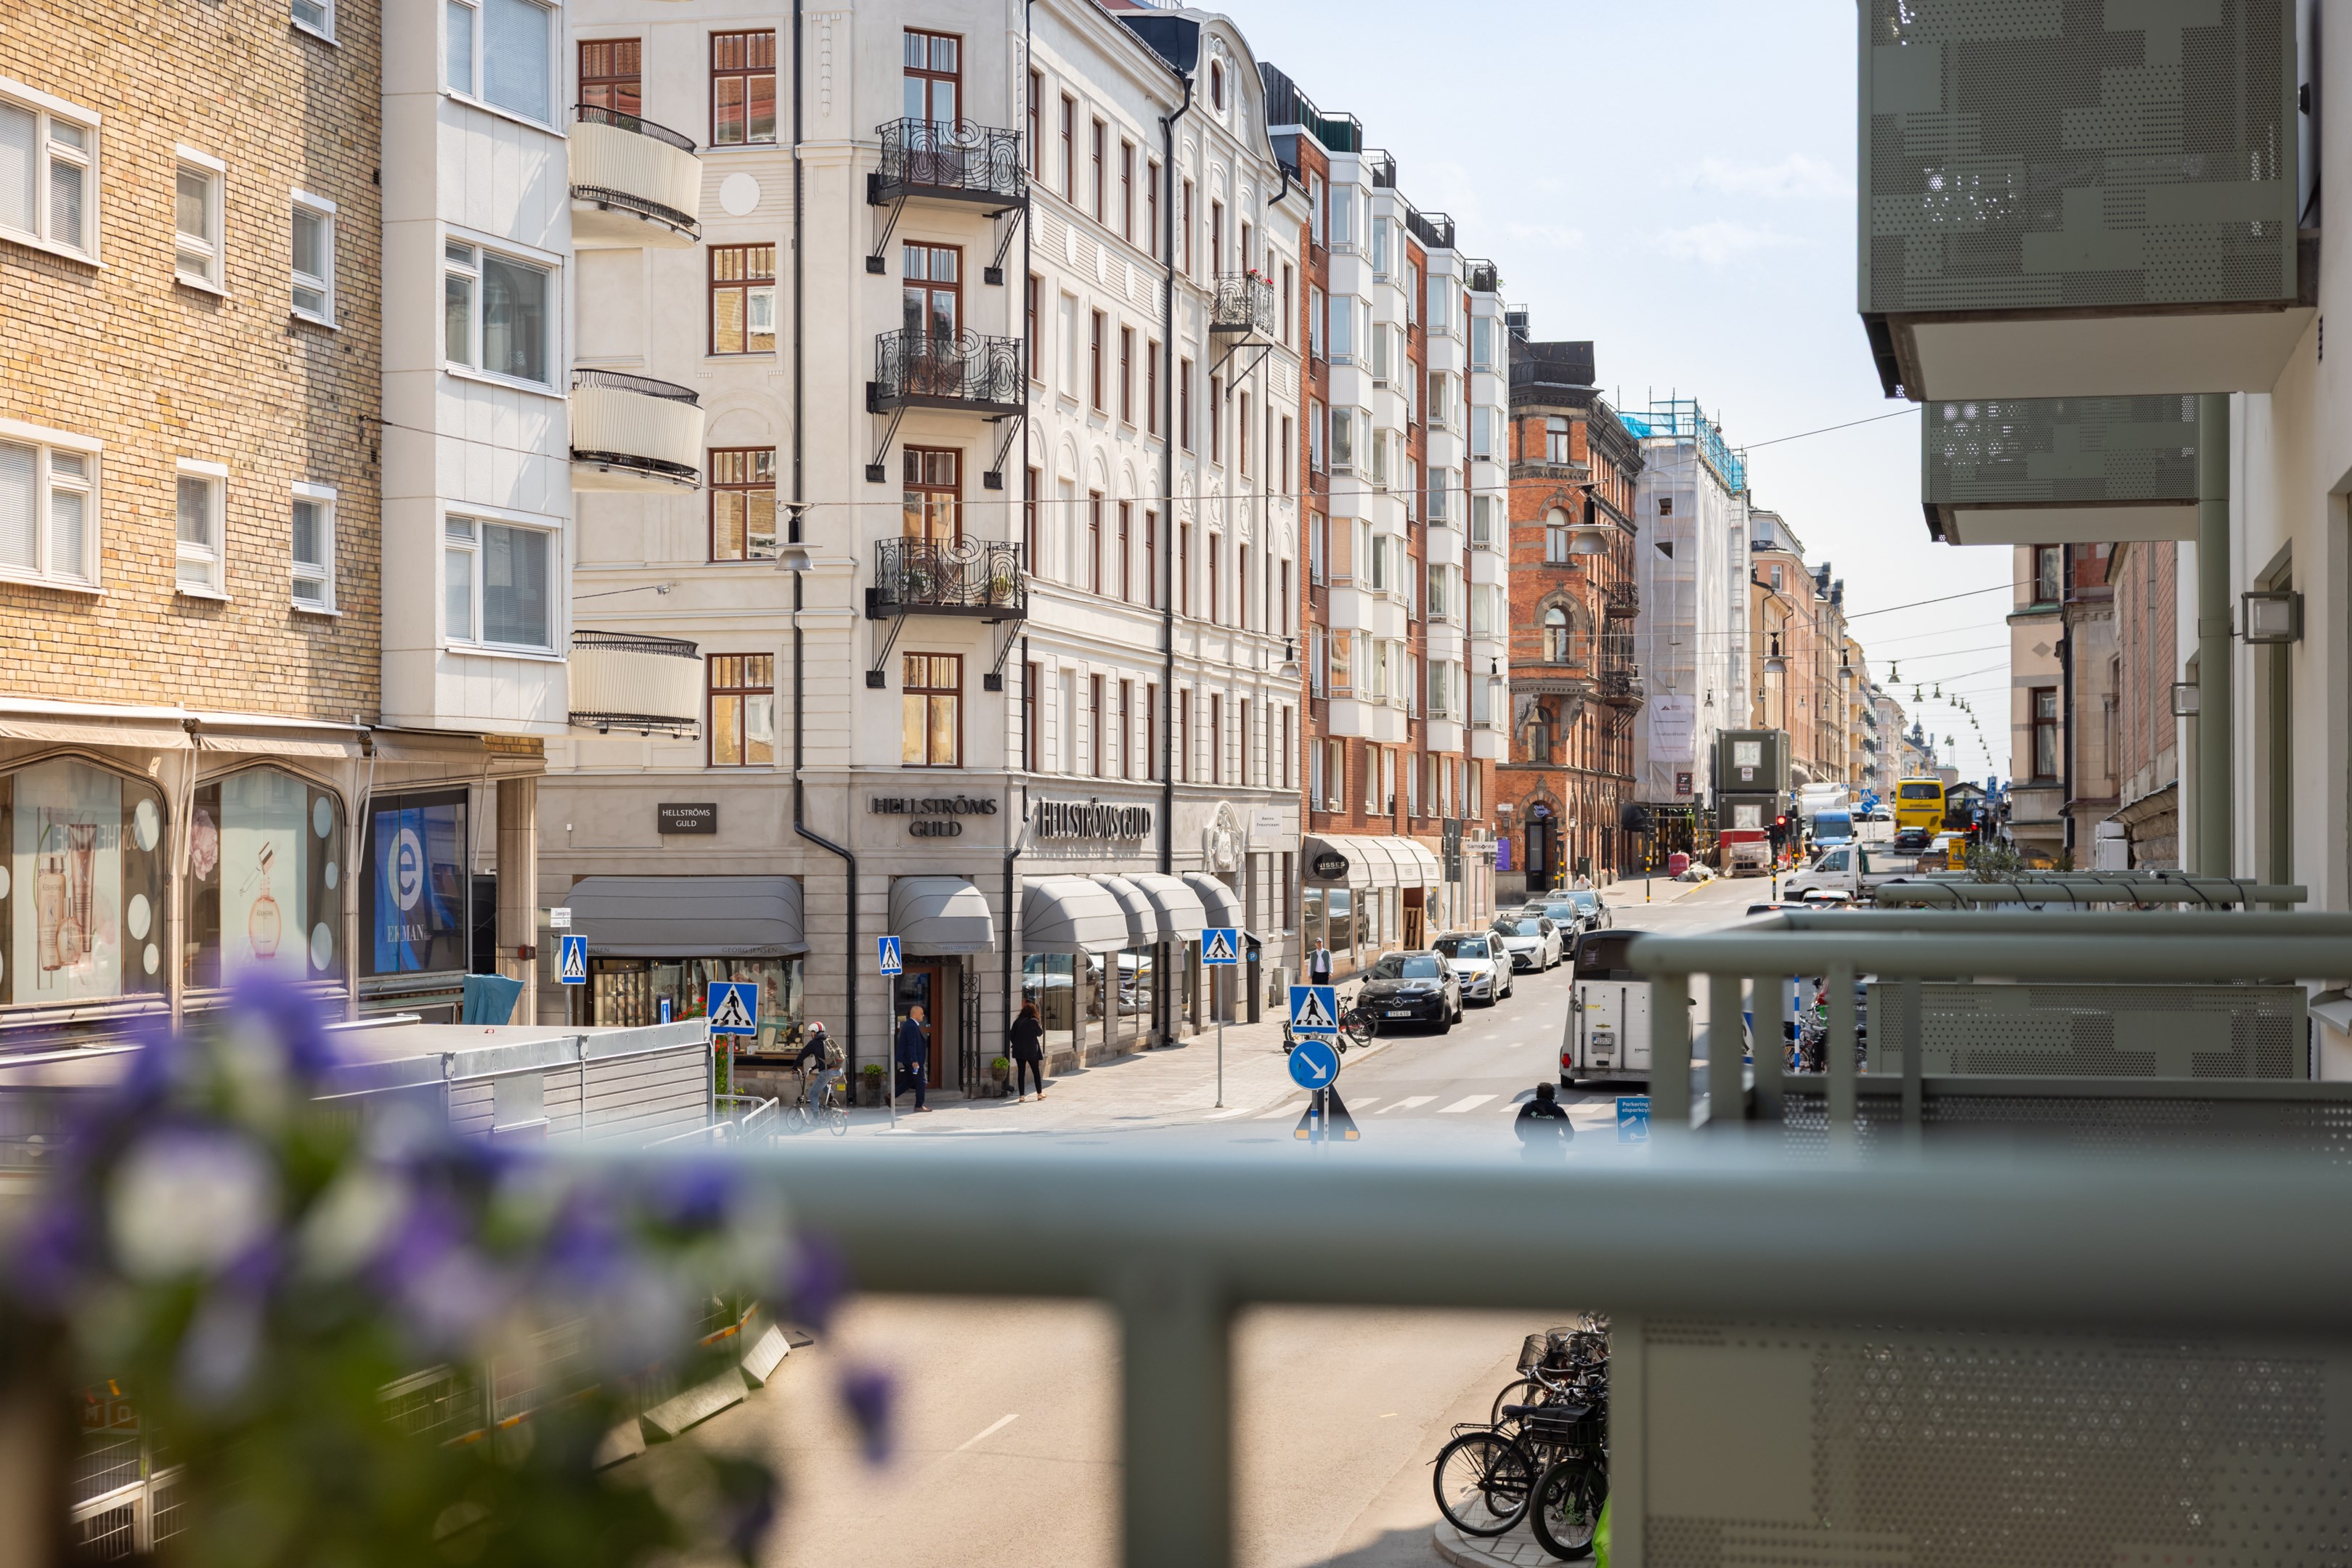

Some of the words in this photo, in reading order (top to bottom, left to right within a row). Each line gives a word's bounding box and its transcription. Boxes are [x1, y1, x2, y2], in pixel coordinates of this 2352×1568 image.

[662, 808, 710, 817] HELLSTRÖMS
[874, 795, 998, 814] HELLSTRÖMS
[1039, 796, 1120, 838] HELLSTRÖMS
[1120, 806, 1151, 839] GULD
[909, 821, 963, 837] GULD
